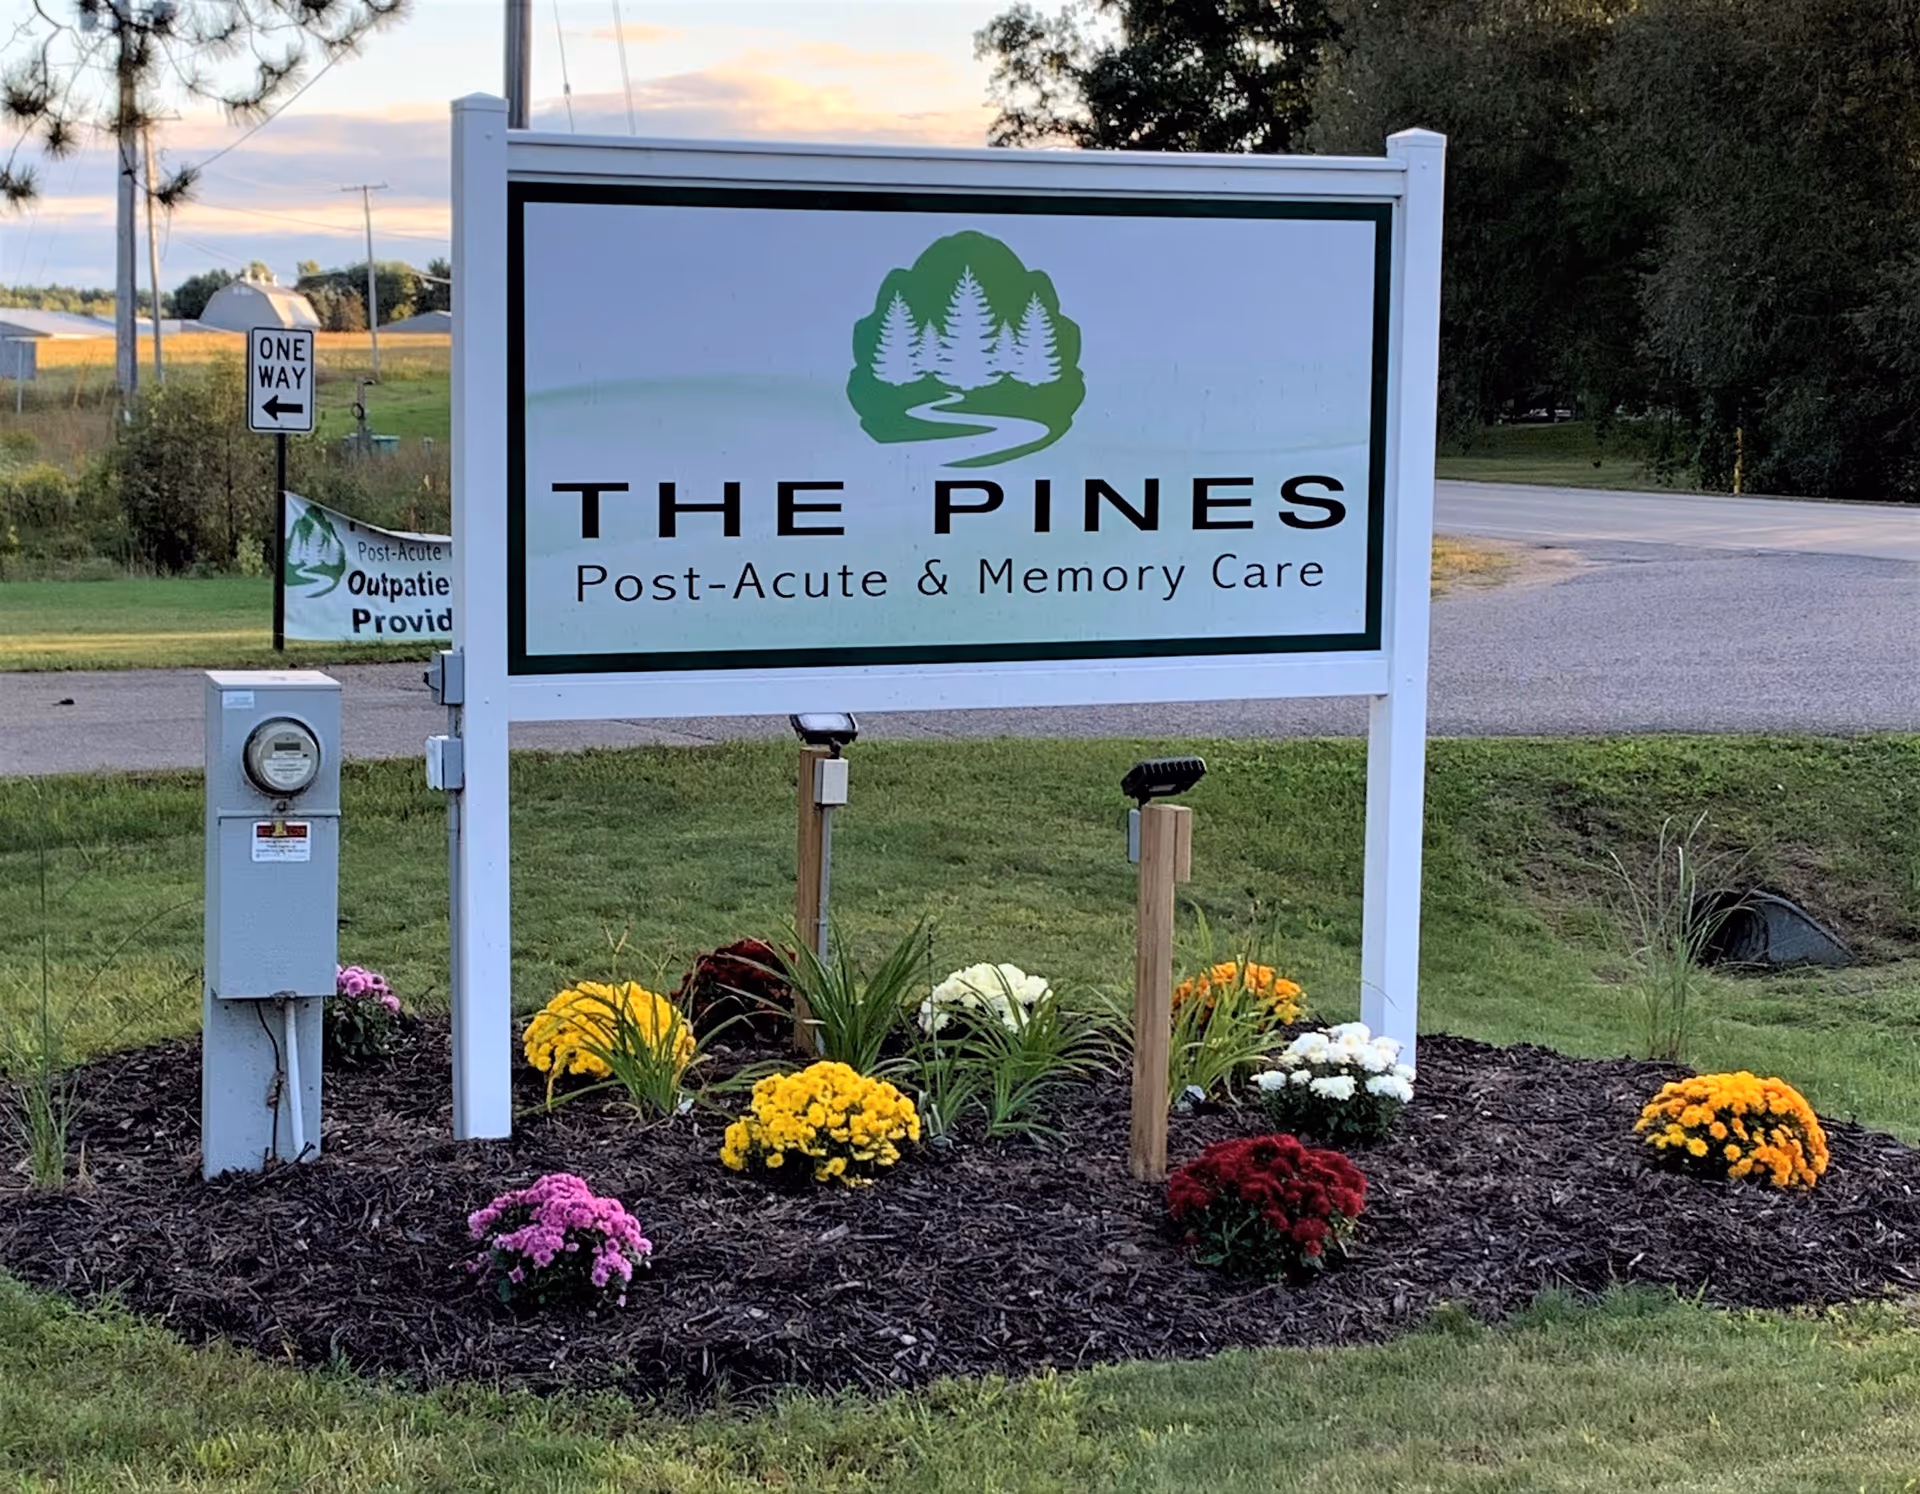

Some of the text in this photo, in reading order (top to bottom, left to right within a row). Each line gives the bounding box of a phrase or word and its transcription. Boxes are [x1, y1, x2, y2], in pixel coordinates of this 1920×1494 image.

[260, 337, 305, 361] ONE
[258, 365, 306, 390] WAY
[552, 475, 1347, 539] THE PINES
[358, 541, 442, 563] Post-Acute
[577, 553, 1324, 602] Post-Acute & Memory Care
[352, 608, 453, 633] Provid
